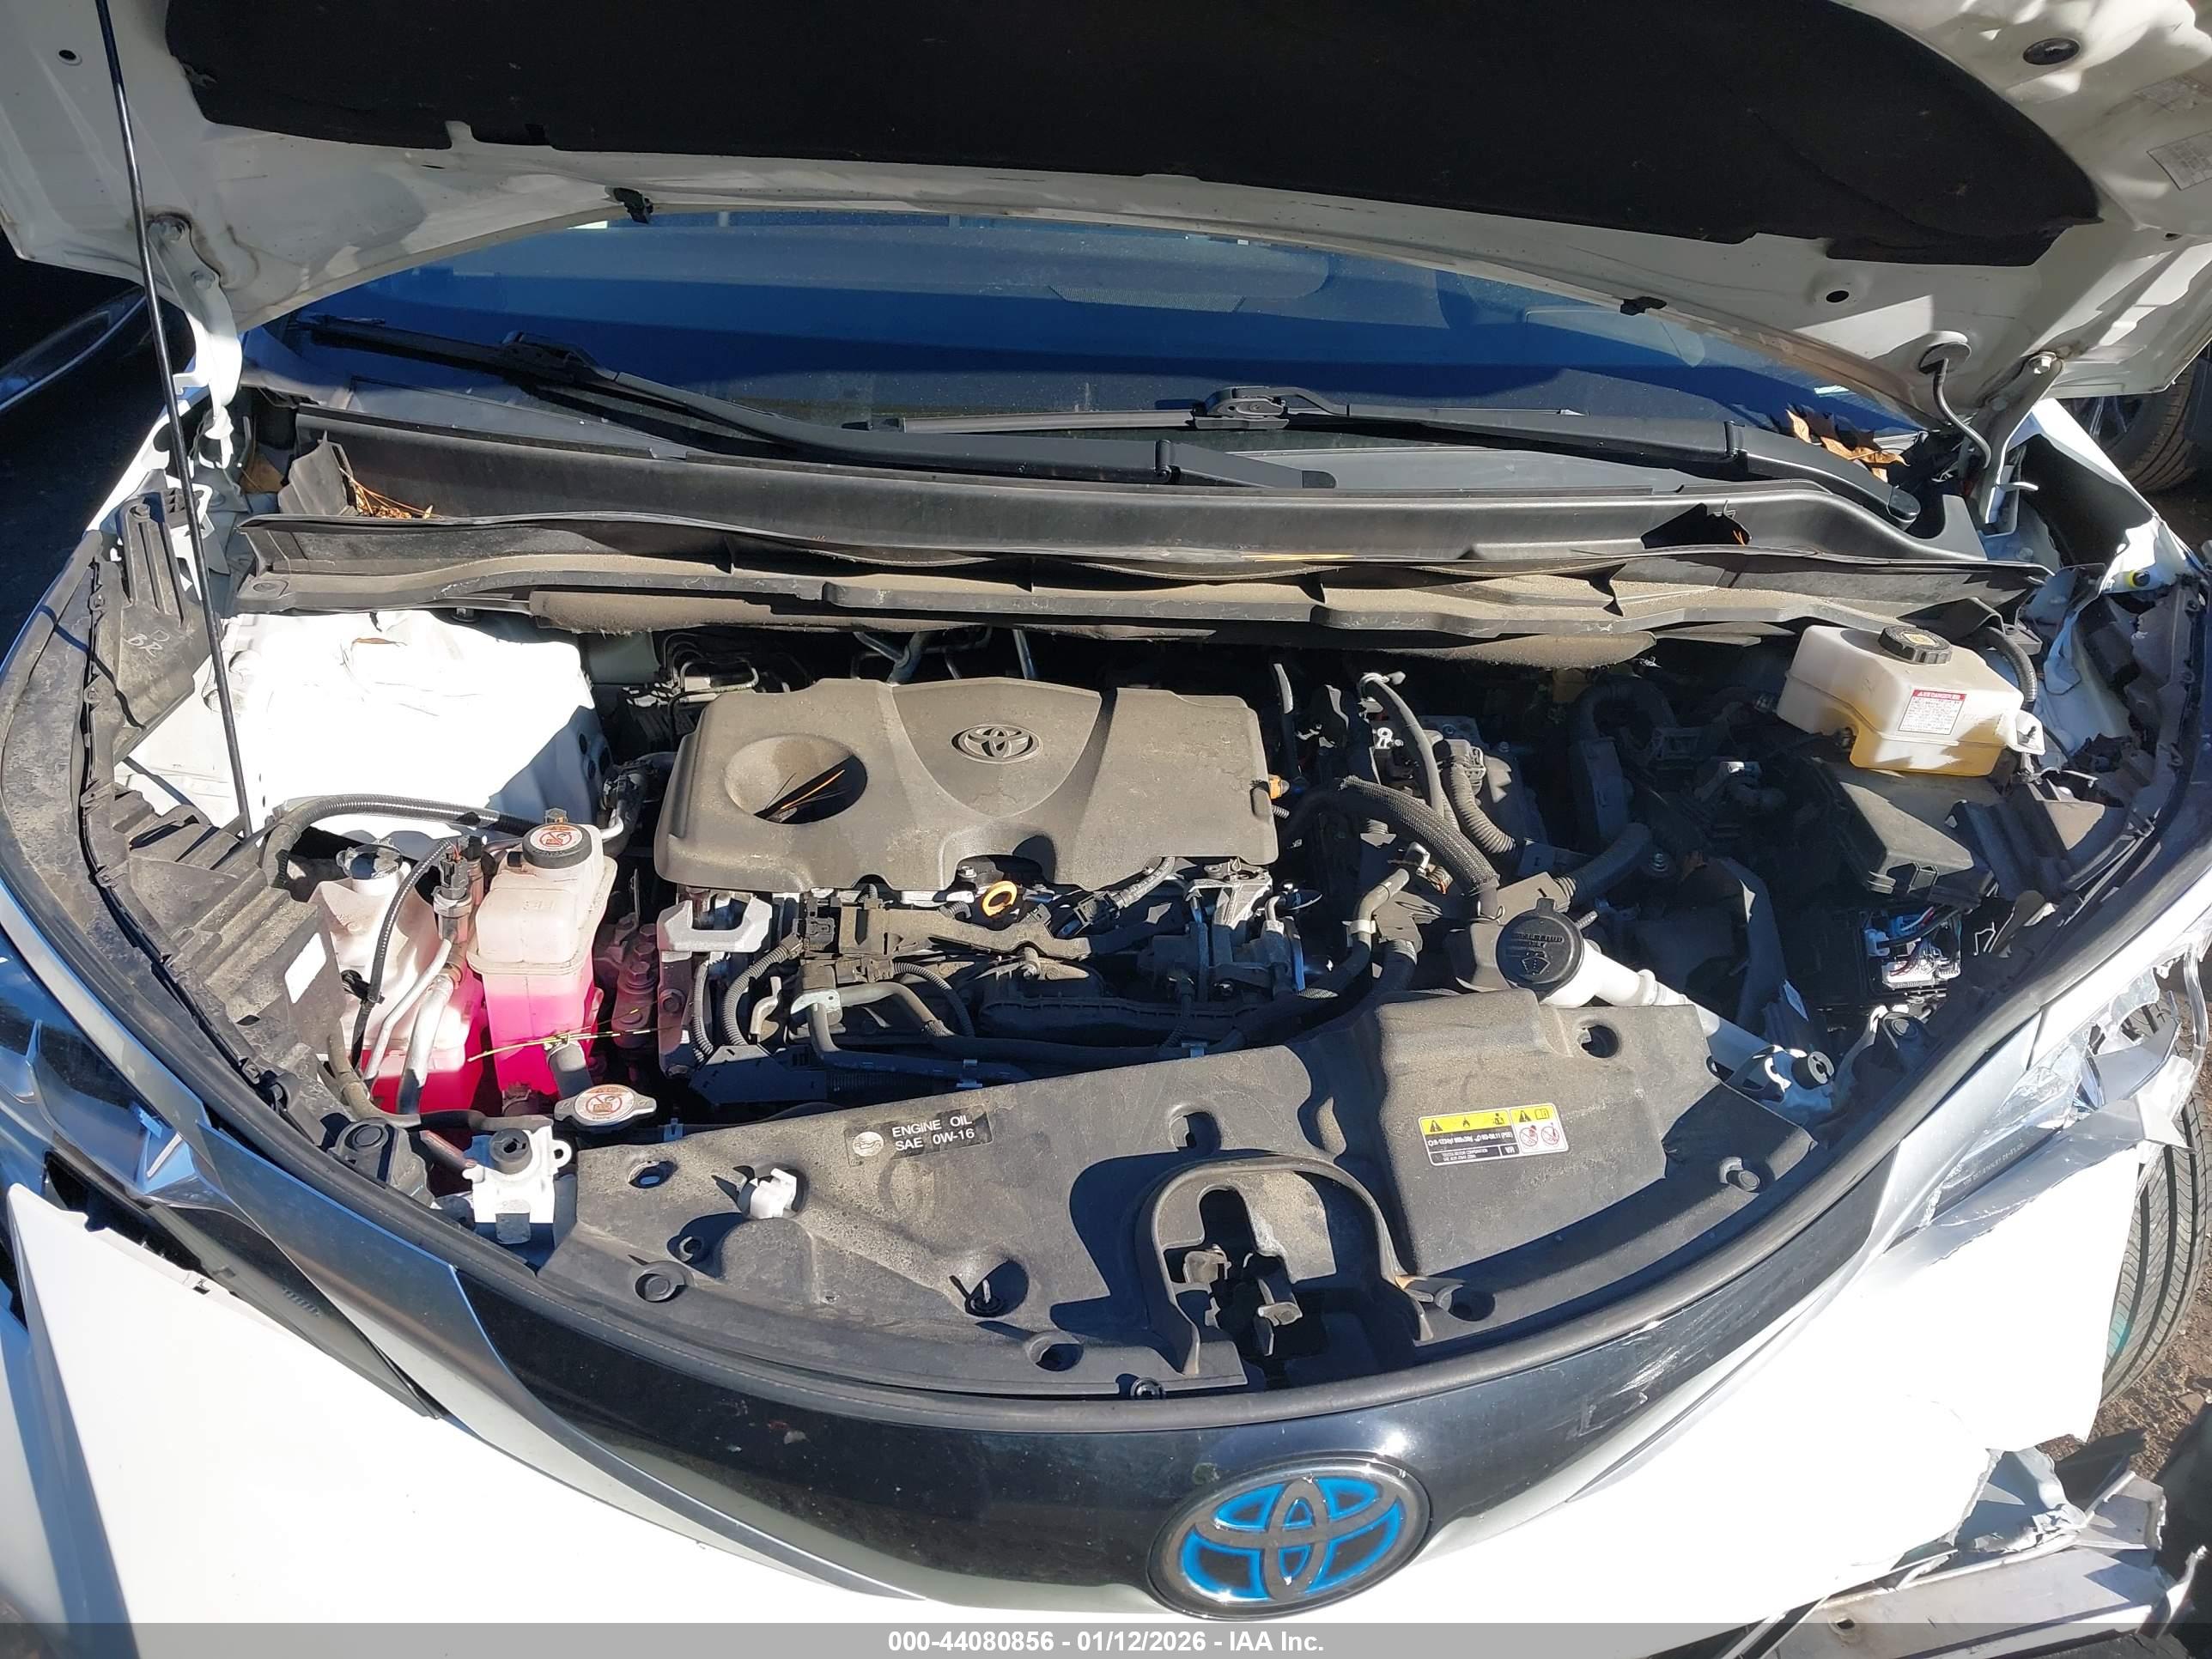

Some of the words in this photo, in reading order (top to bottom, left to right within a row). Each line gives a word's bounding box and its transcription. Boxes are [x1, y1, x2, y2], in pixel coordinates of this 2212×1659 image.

[891, 1119, 942, 1138] ENGINE
[950, 1115, 972, 1127] OIL
[895, 1137, 923, 1152] SAE
[933, 1128, 975, 1145] 0W-16
